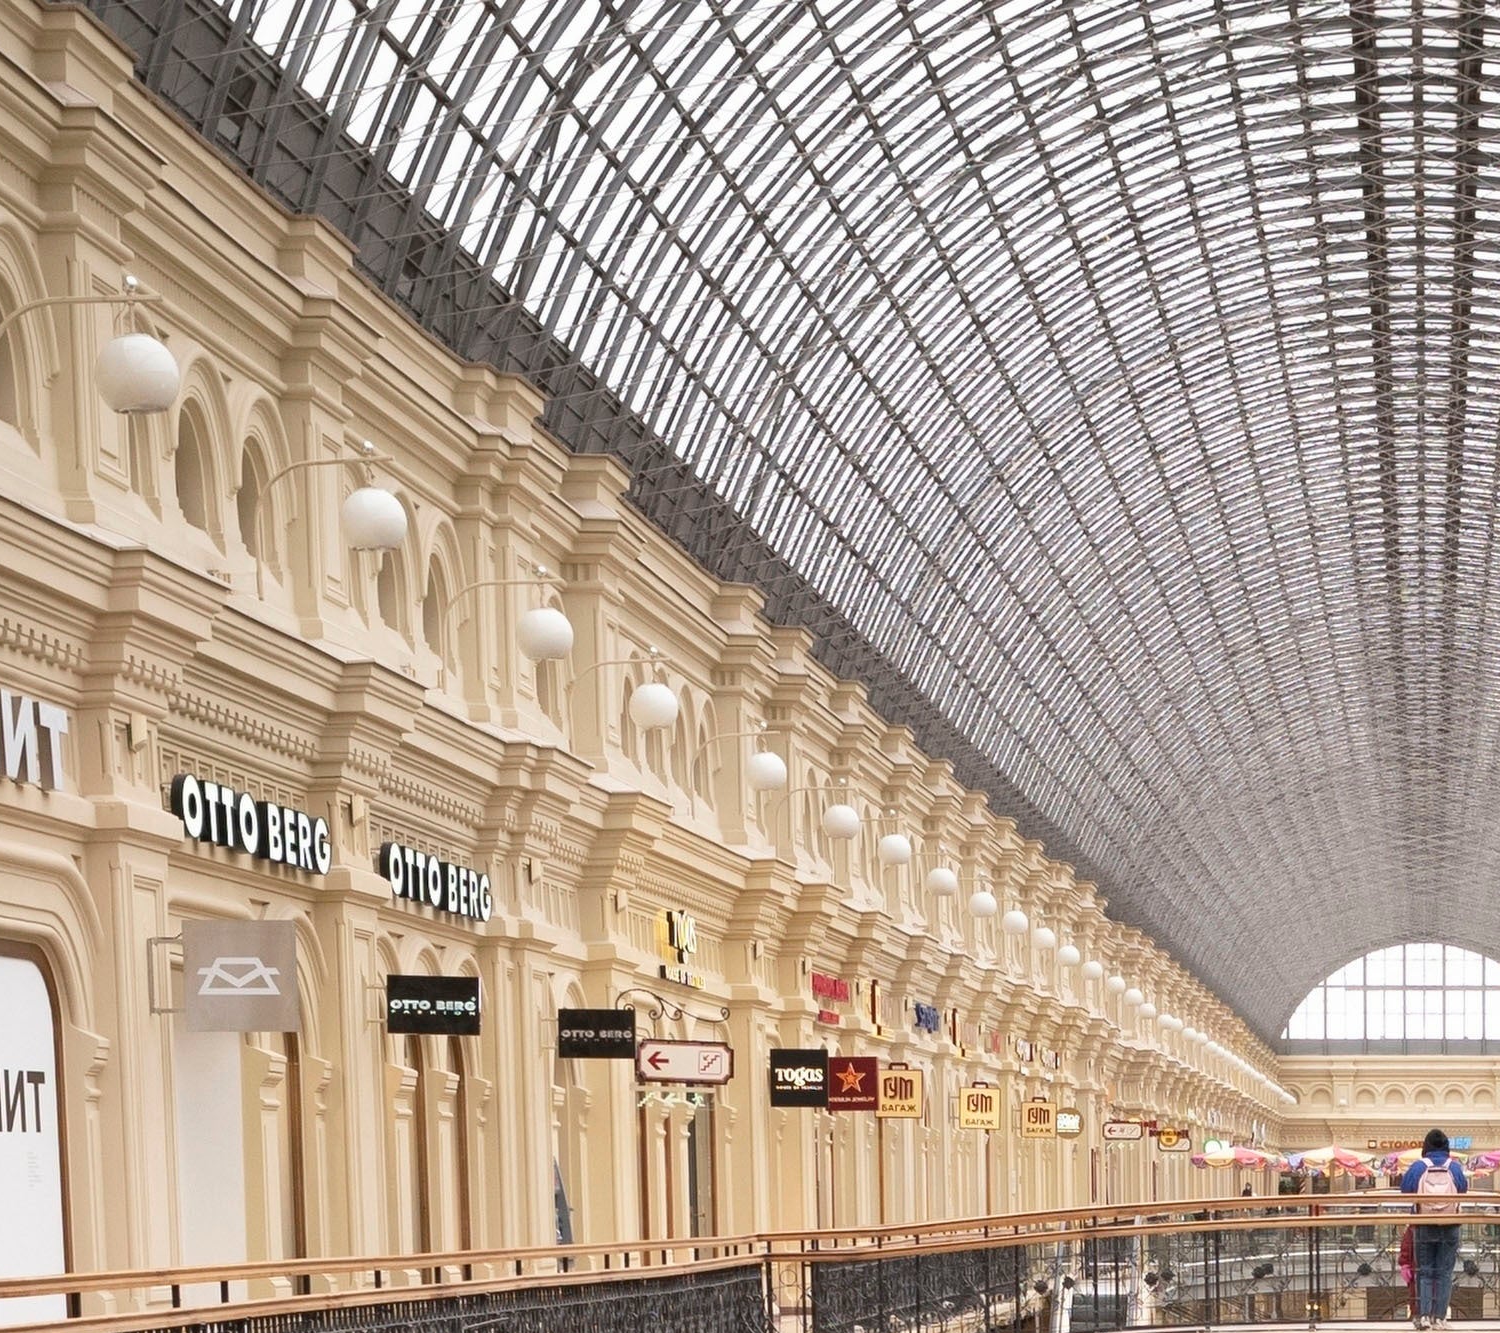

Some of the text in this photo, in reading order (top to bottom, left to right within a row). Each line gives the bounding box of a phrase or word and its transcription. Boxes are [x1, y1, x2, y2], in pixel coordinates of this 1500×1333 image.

[180, 774, 333, 875] OTTO BERG
[386, 842, 493, 922] OTTO BERG
[390, 999, 477, 1012] OTTO BERG
[883, 1076, 914, 1100] ГУМ
[881, 1104, 917, 1112] БАГАЖ
[967, 1093, 993, 1114] ГУМ
